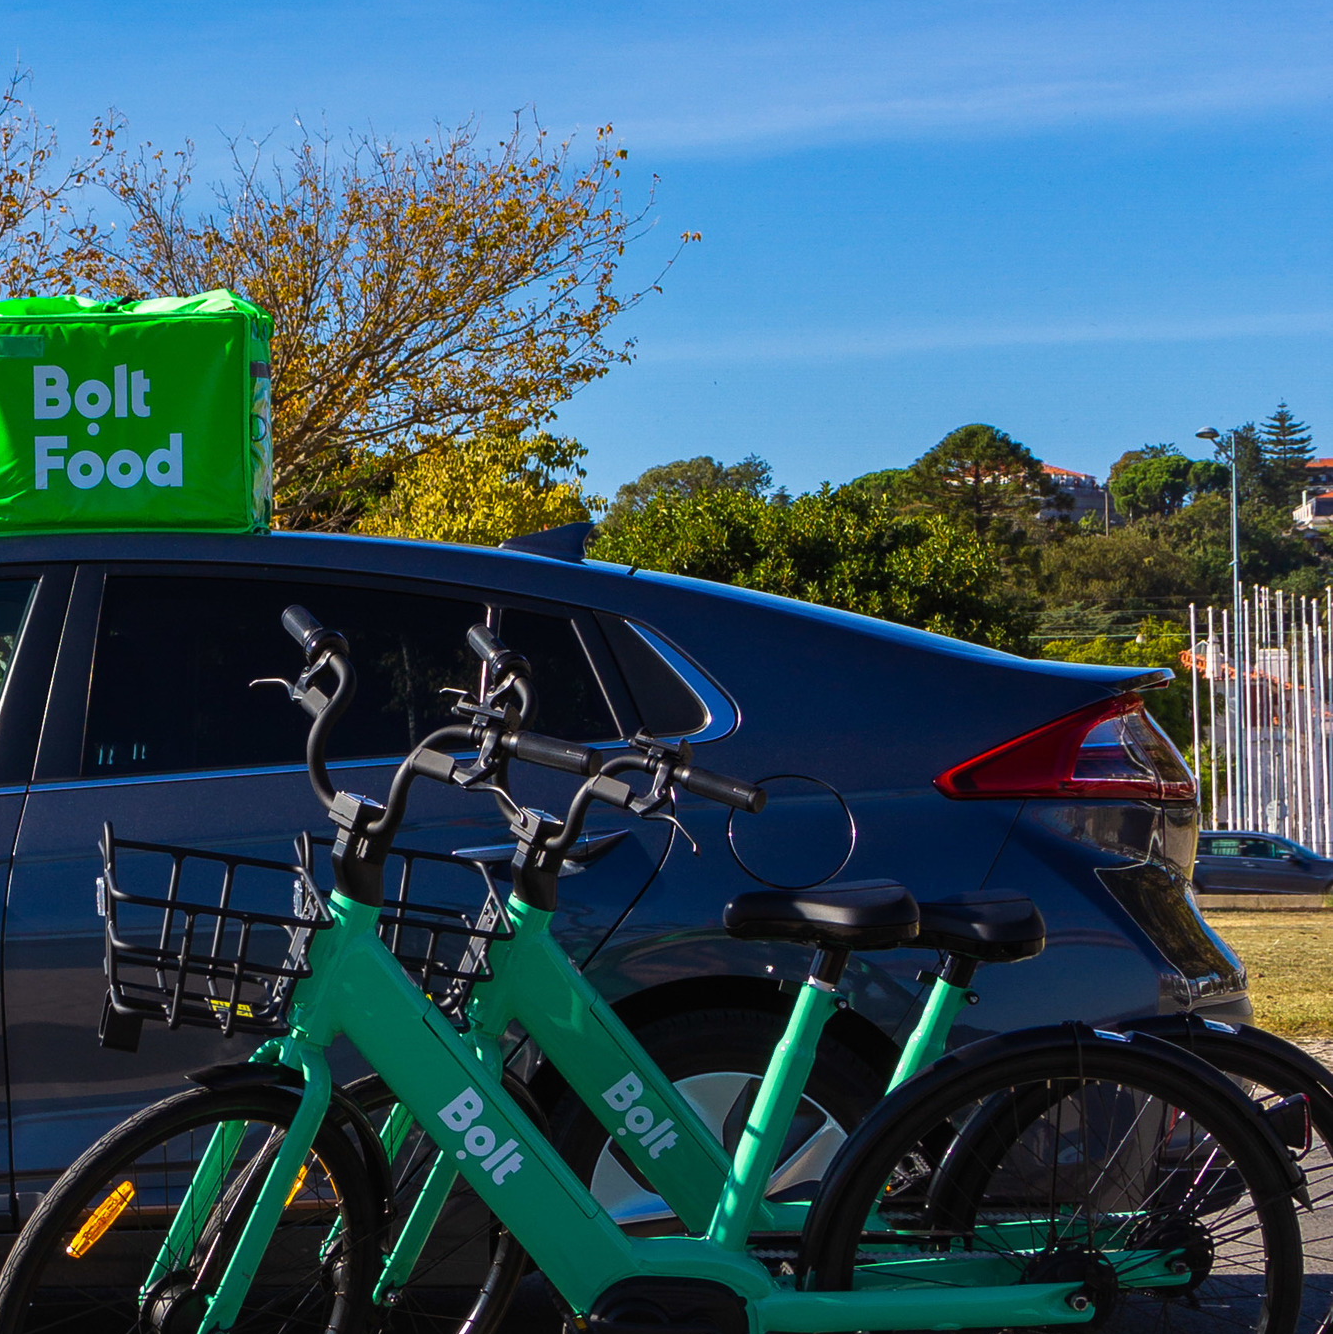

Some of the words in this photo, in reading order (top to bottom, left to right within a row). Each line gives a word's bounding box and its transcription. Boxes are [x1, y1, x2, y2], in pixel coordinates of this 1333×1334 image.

[33, 364, 151, 436] Bolt
[34, 433, 183, 490] Food
[437, 1086, 524, 1186] Bolt
[601, 1071, 679, 1160] Bolt
